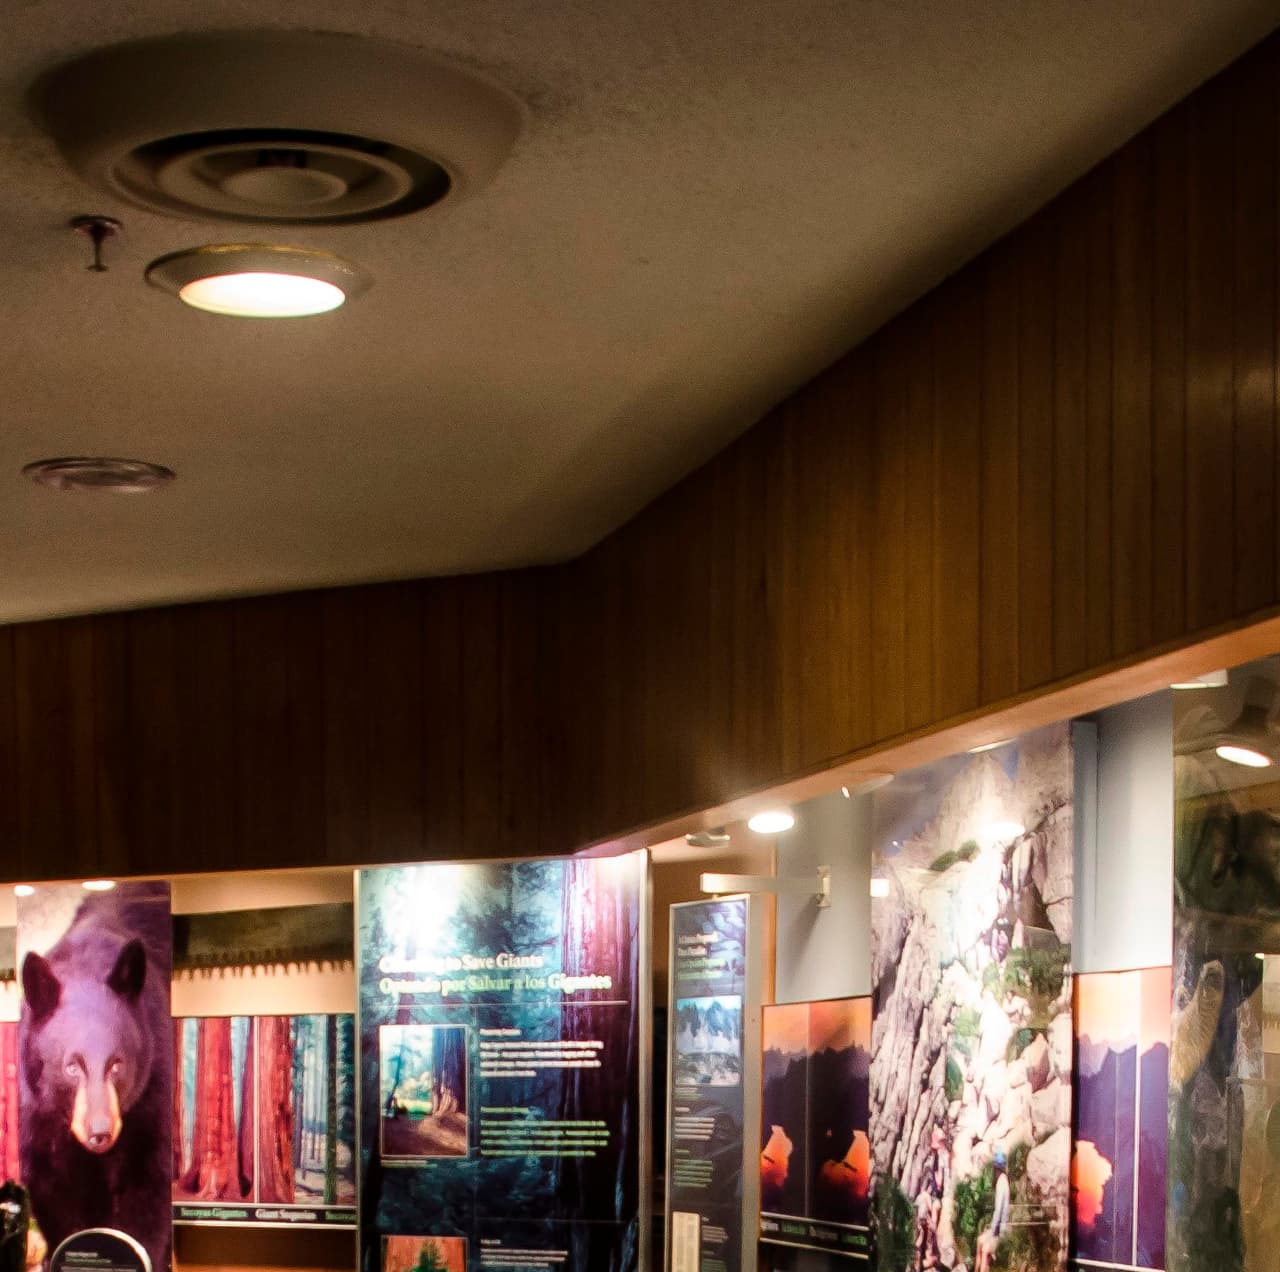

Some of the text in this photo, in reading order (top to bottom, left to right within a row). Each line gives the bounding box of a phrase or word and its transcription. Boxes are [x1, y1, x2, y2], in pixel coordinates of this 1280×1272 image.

[462, 955, 494, 970] Save
[496, 953, 544, 969] Giants
[467, 976, 511, 992] Salvar
[525, 975, 545, 990] los
